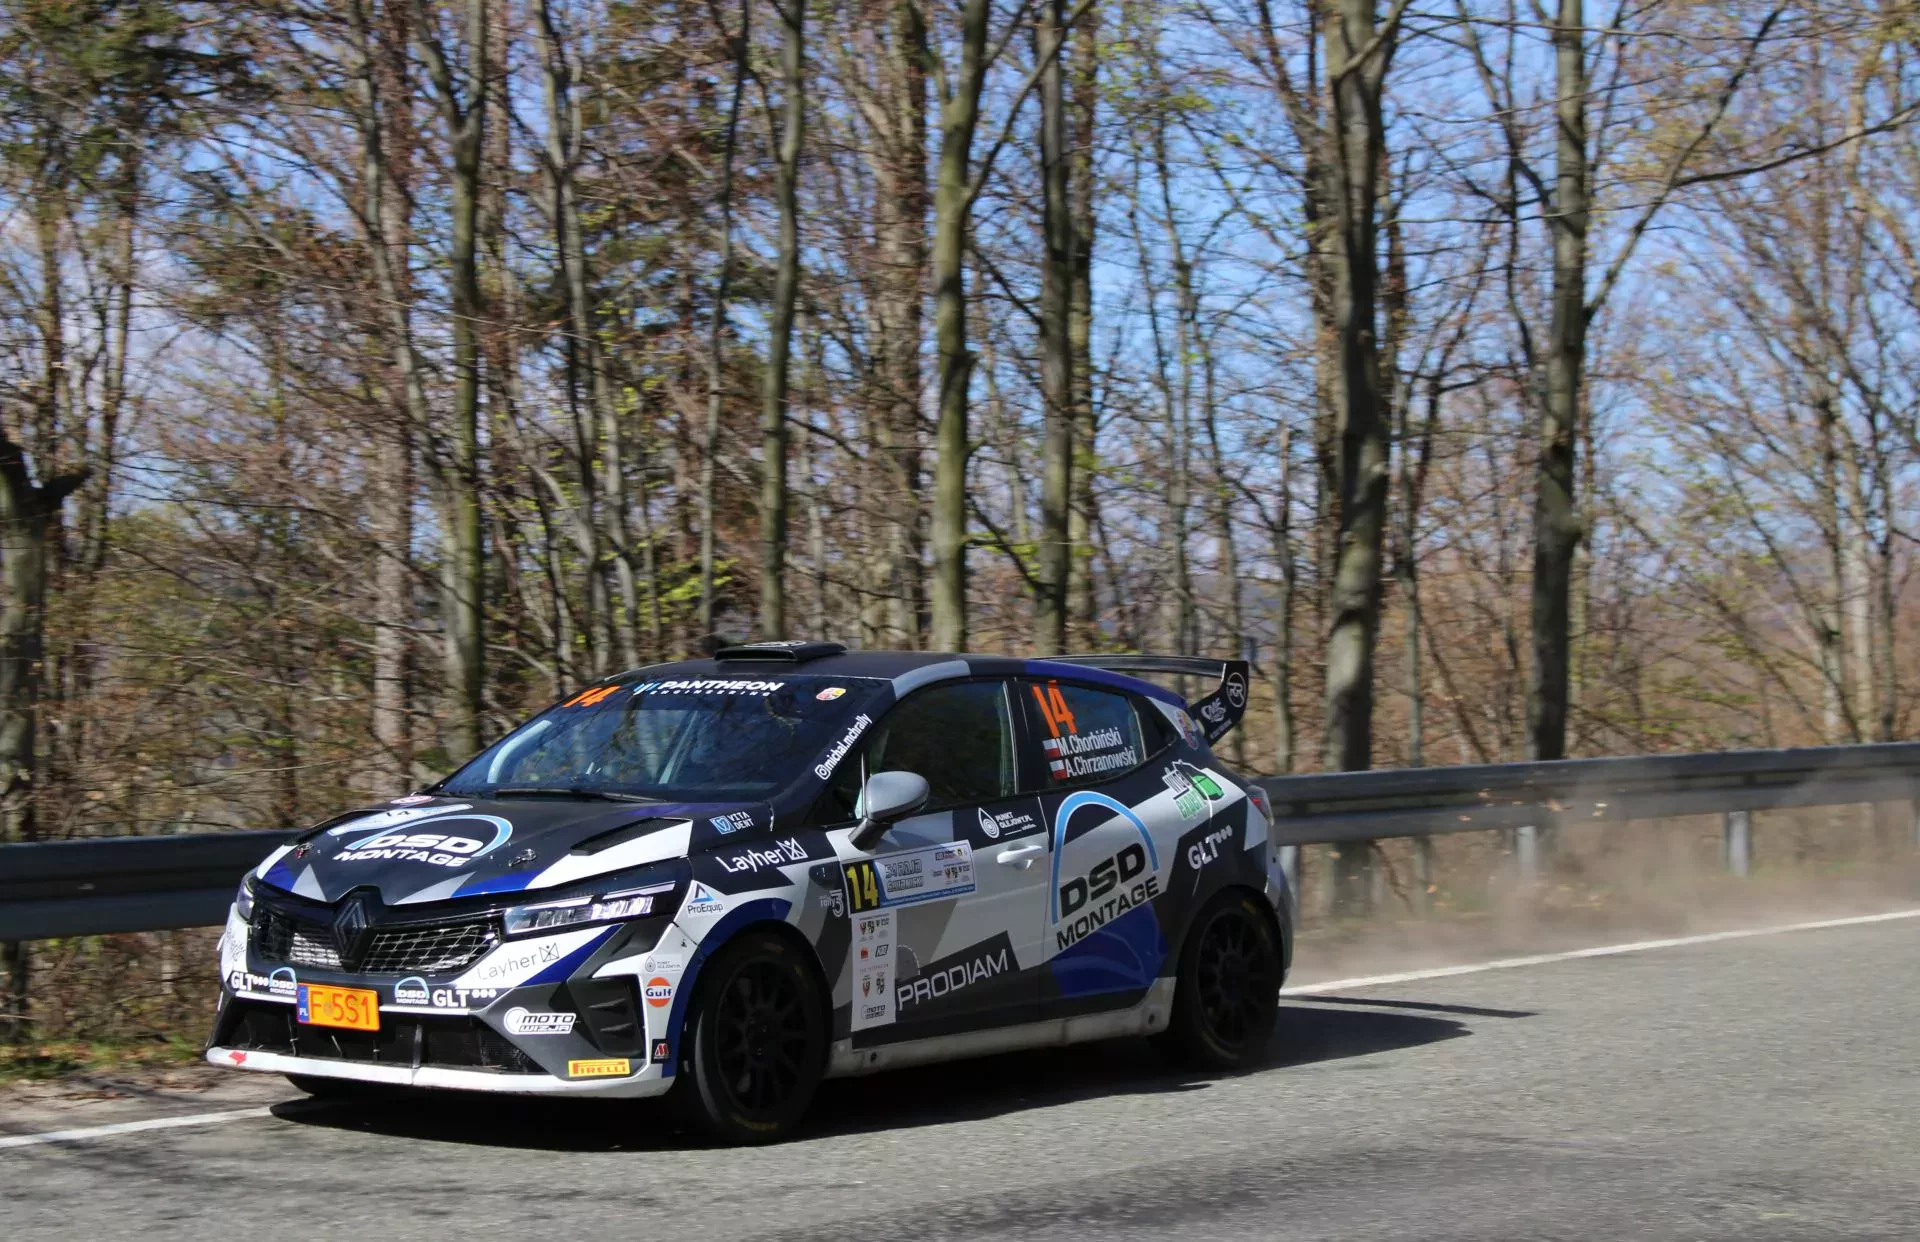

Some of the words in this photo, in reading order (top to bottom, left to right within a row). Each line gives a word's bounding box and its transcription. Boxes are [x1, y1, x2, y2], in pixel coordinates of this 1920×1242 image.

[650, 689, 771, 697] ENGINEERING
[657, 679, 785, 692] PANTHEON
[562, 685, 621, 708] 14
[1031, 680, 1078, 739] 14
[814, 713, 873, 780] @michal.mchrally
[1056, 727, 1123, 757] M.Chorbiński
[1065, 746, 1138, 778] A.Chrzanowski
[727, 811, 750, 821] VITA
[733, 818, 754, 830] DENT
[995, 811, 1013, 822] PUNKT
[360, 834, 484, 854] DSD
[1188, 832, 1220, 870] GLT
[333, 849, 473, 867] MONTAGE
[715, 848, 786, 873] Layher
[846, 863, 879, 911] 14
[1060, 843, 1146, 918] DSD
[687, 902, 724, 916] ProEquip
[1056, 875, 1161, 951] MONTAGE
[477, 952, 537, 981] Layher
[231, 971, 254, 991] GLT
[896, 948, 1009, 1012] PRODIAM
[397, 989, 429, 998] DSD
[432, 988, 470, 1008] GLT
[645, 988, 673, 997] Gulf
[310, 990, 323, 1019] F
[522, 1014, 575, 1024] MOTO
[572, 1060, 627, 1075] PIRELLI
